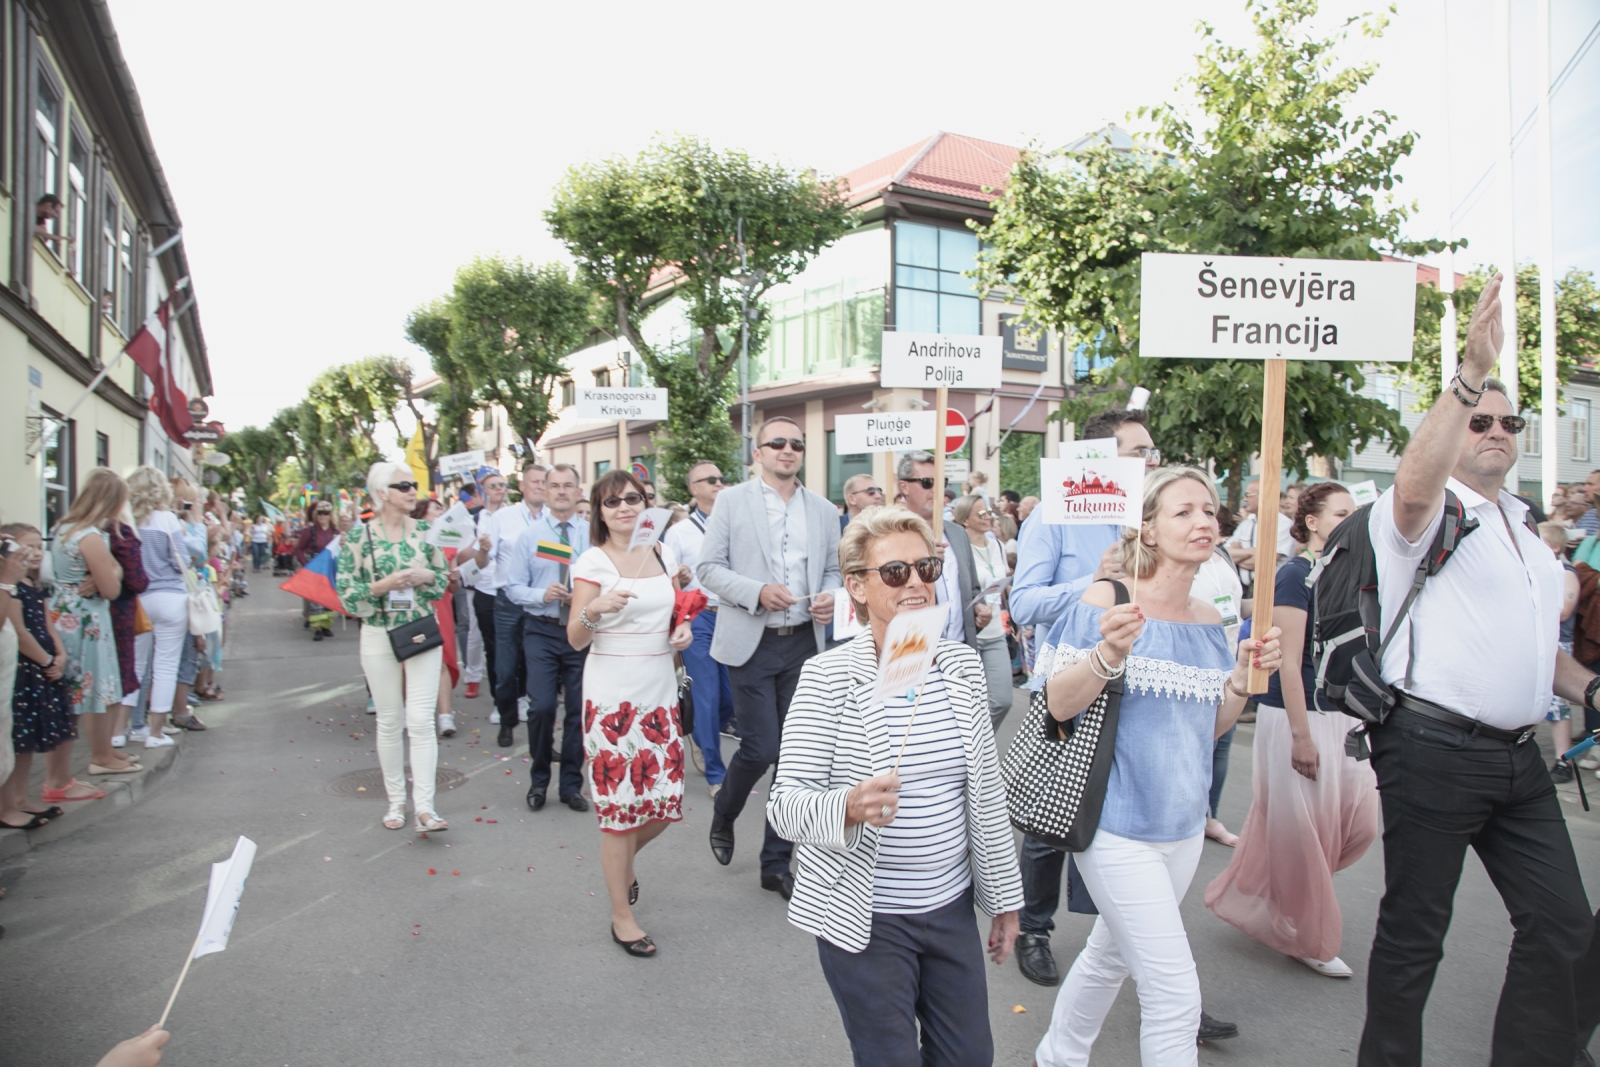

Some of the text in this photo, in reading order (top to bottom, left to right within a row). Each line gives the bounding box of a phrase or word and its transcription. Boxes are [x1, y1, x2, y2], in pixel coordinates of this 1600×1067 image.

[1196, 261, 1356, 307] Šenevjēra
[1211, 314, 1338, 352] Francija
[908, 340, 981, 358] Andrihova
[925, 365, 963, 385] Polija
[584, 391, 657, 403] Krasnogorska
[601, 405, 642, 417] Krievija
[867, 417, 911, 432] Pluņģe
[866, 435, 913, 447] Lietuva
[1064, 498, 1126, 514] Tukums
